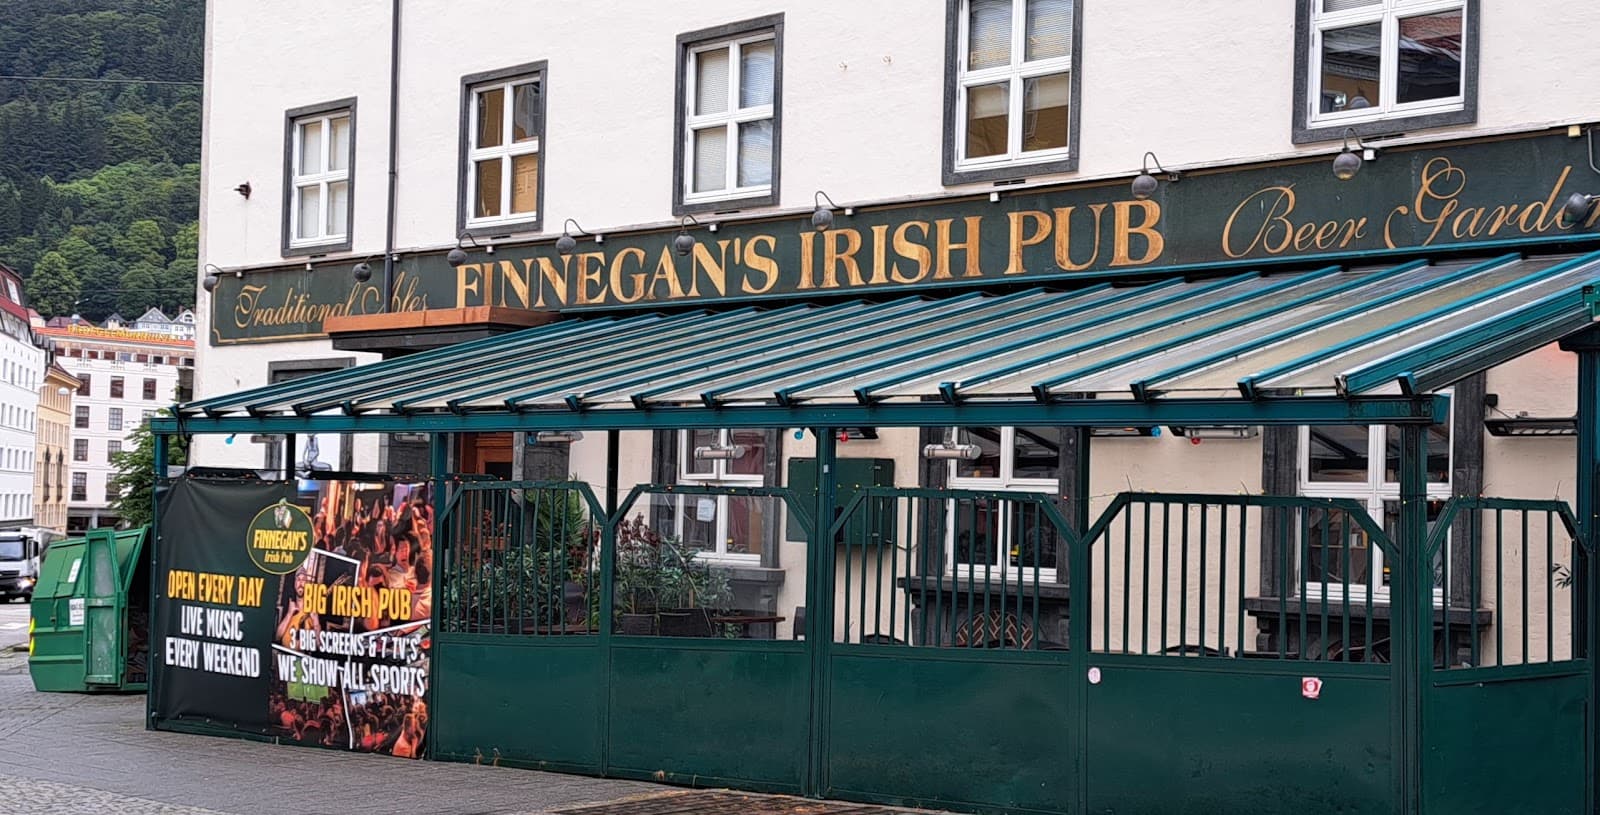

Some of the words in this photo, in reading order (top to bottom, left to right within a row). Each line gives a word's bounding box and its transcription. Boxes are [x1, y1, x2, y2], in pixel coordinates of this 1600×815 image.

[1222, 183, 1367, 258] Beer
[1384, 157, 1600, 249] Gard
[456, 235, 779, 309] FINNEGAN'S
[796, 216, 983, 290] IRISH
[1004, 200, 1164, 275] PUB
[234, 281, 361, 329] Traditional
[253, 529, 308, 552] FINNEGAN'S
[168, 569, 196, 600] OPEN
[198, 572, 235, 605] EVERY
[237, 576, 264, 607] DAY
[303, 583, 327, 615] BIG
[332, 585, 372, 618] IRISH
[378, 588, 412, 621] PUB
[181, 605, 204, 636] LIVE
[206, 608, 244, 641] MUSIC
[165, 636, 200, 669] EVERY
[202, 641, 260, 678] WEEKEND
[289, 628, 296, 649] 3
[300, 629, 316, 651] BIG
[319, 631, 365, 657] SCREENS
[369, 636, 377, 657] &
[381, 636, 388, 658] 7
[392, 636, 419, 661] TV'S
[277, 654, 297, 683] WE
[301, 656, 338, 687] SHOW
[343, 661, 366, 690] ALL
[371, 663, 425, 697] SPORTS
